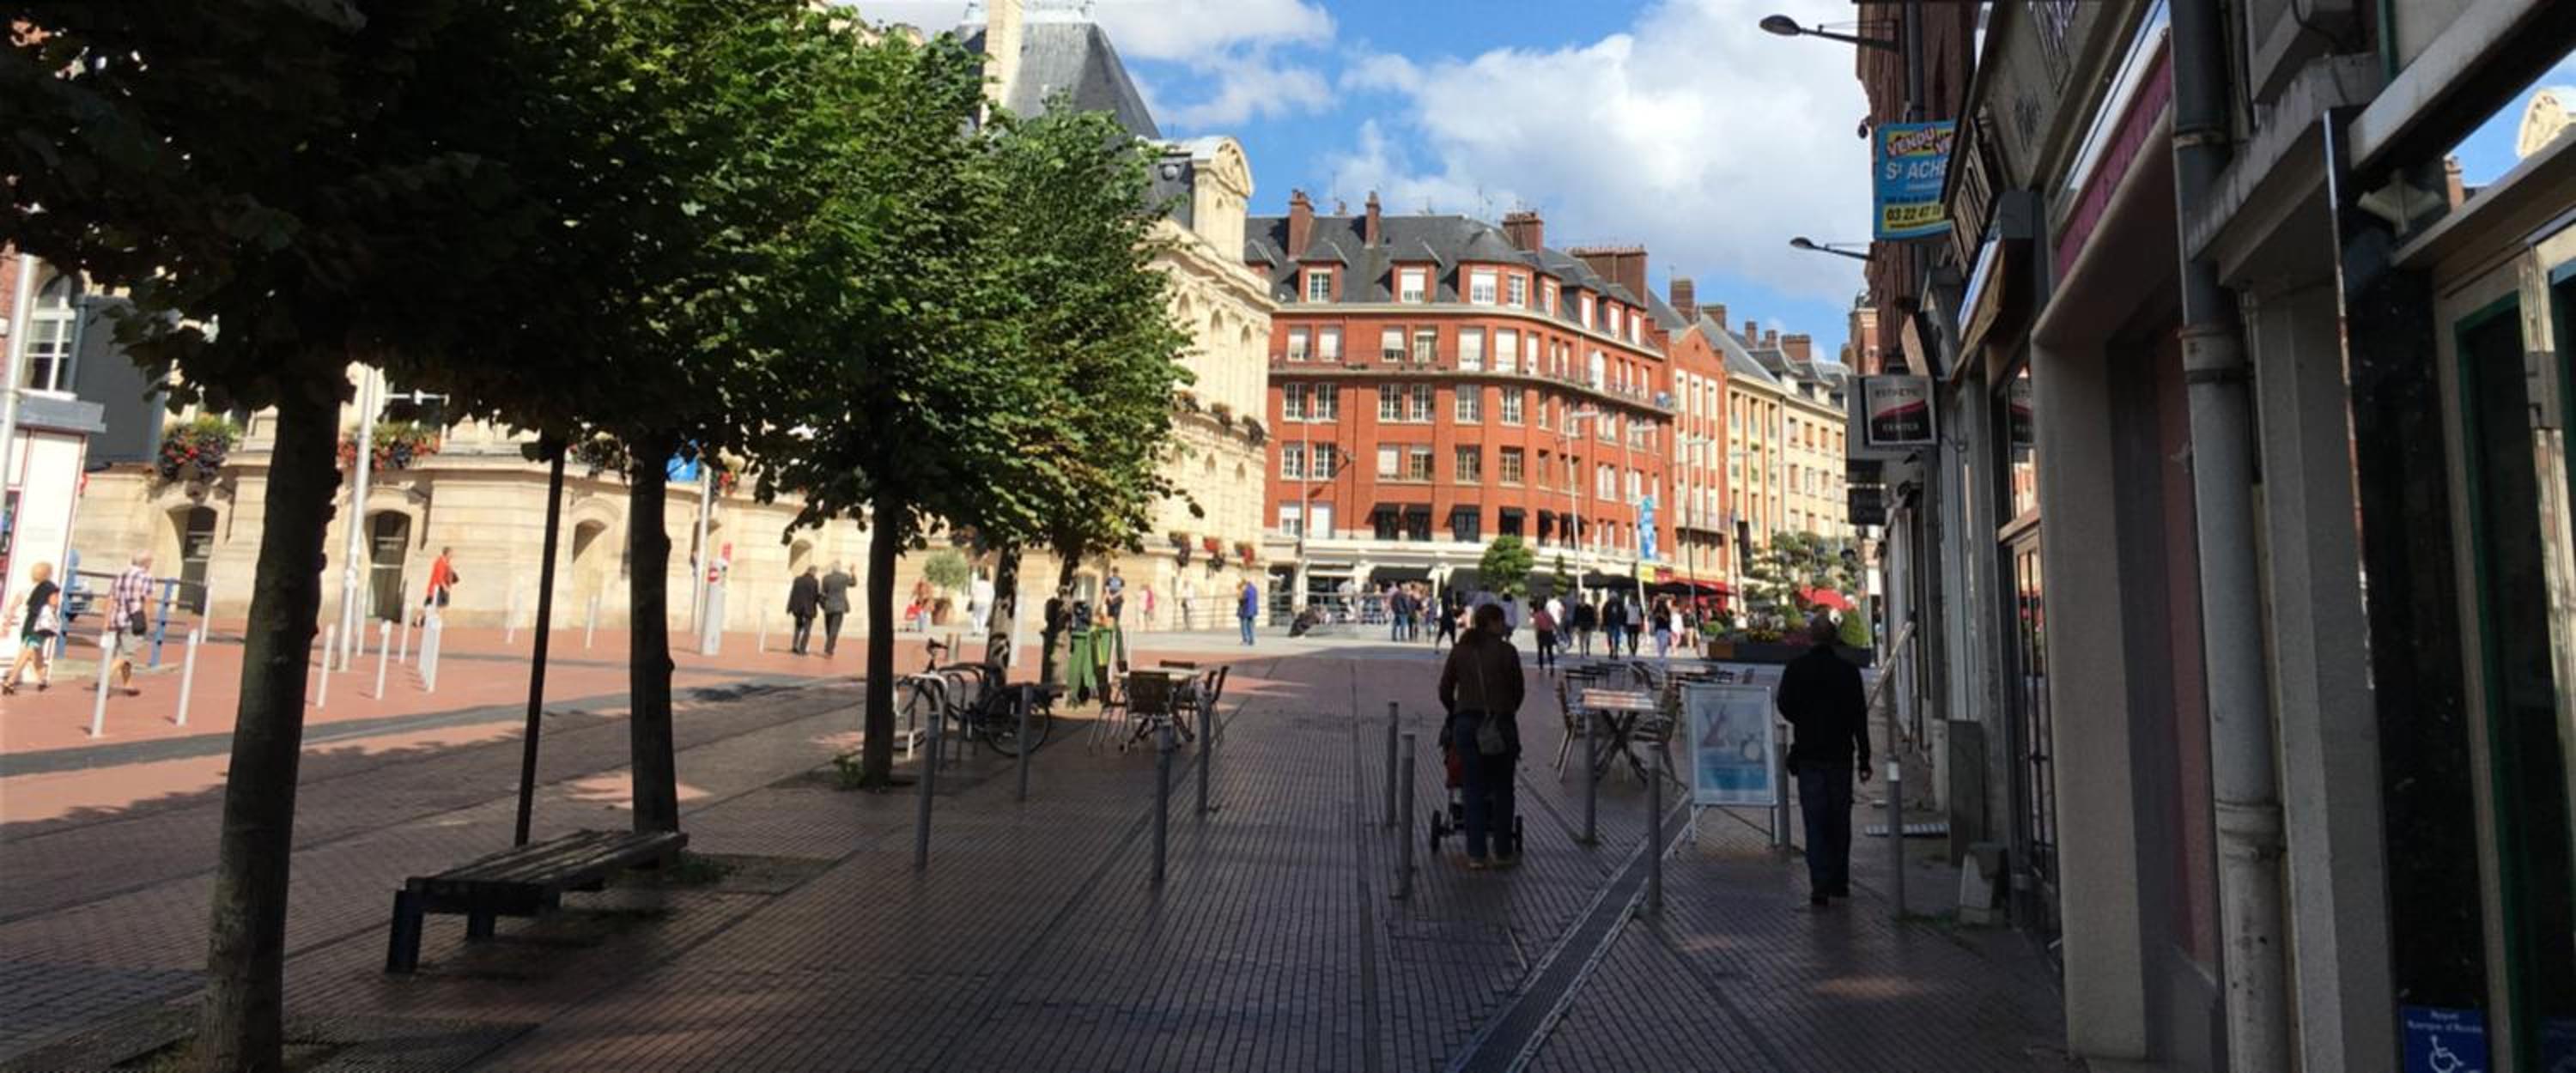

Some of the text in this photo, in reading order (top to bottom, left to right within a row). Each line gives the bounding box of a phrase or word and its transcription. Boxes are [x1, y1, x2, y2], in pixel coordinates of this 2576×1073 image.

[1886, 126, 1936, 157] VENDU
[1886, 205, 1901, 221] 03
[1903, 205, 1917, 220] 22
